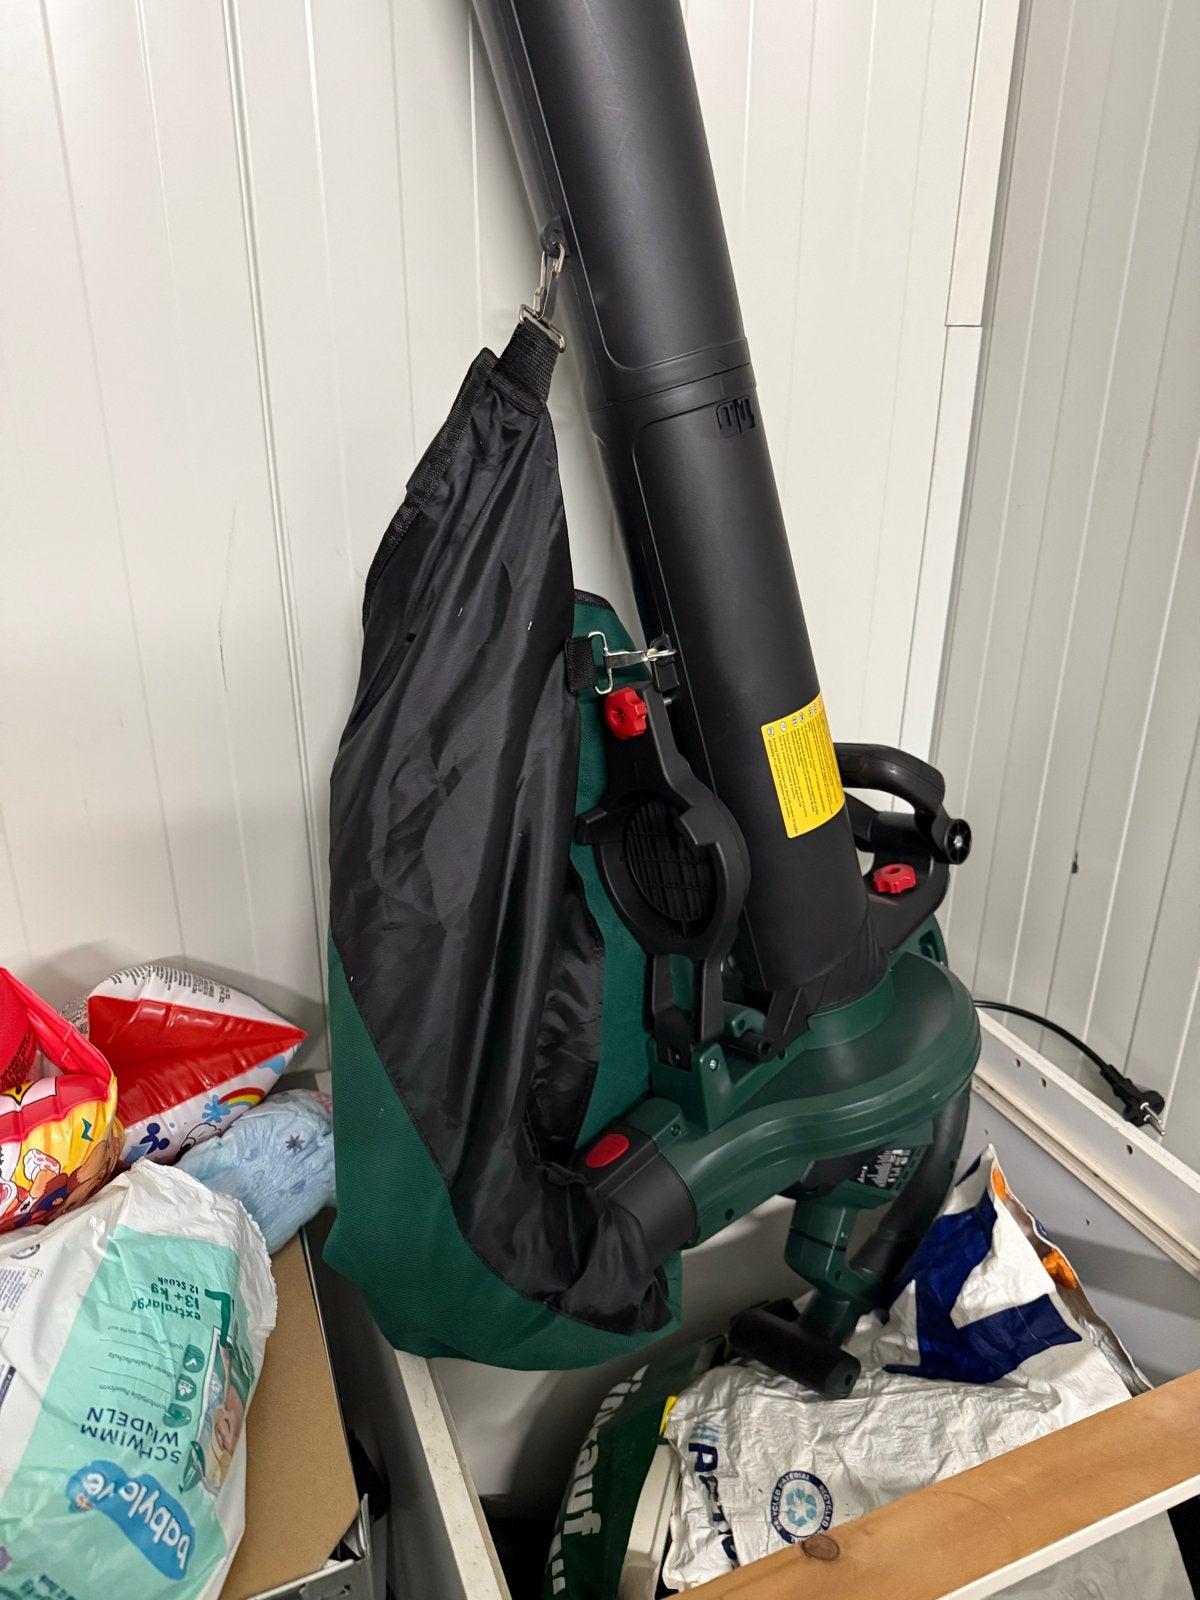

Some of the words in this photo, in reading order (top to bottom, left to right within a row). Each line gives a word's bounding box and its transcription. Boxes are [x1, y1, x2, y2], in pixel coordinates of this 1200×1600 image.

[150, 1283, 169, 1302] kg
[174, 1292, 199, 1310] 13+
[189, 1284, 199, 1295] 12
[86, 1407, 179, 1447] WINDELN
[80, 1424, 182, 1464] SCHWIMM
[83, 1473, 191, 1570] babylove
